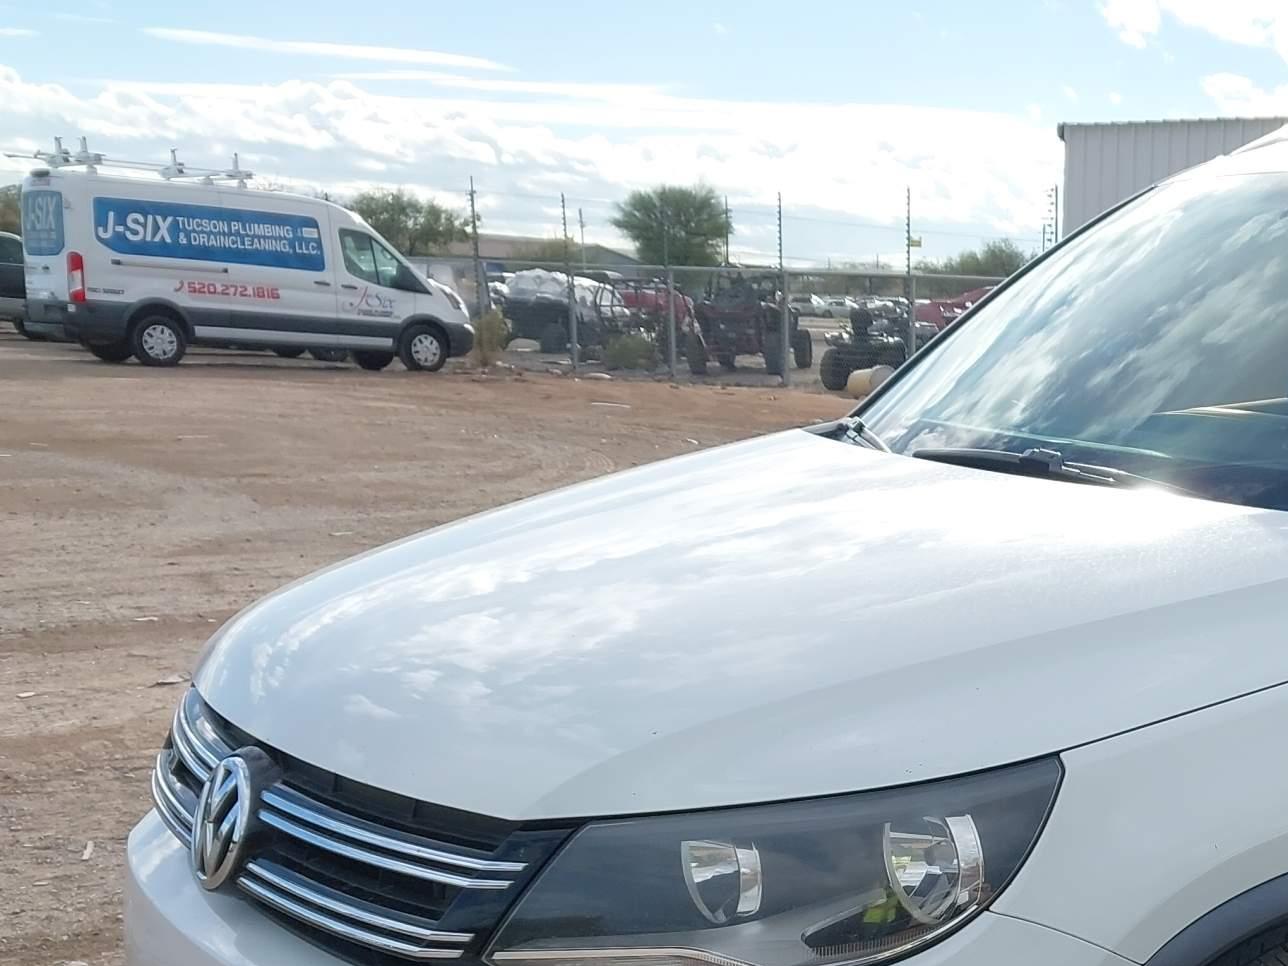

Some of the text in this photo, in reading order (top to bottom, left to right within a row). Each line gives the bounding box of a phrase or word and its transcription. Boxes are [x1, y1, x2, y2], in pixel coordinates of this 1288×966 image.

[97, 210, 174, 243] J-SIX
[176, 216, 228, 233] TUCSON
[231, 221, 293, 238] PLUMBING
[178, 232, 321, 255] & DRAINCLEANING, LLC.
[187, 281, 281, 300] 520.272.1816
